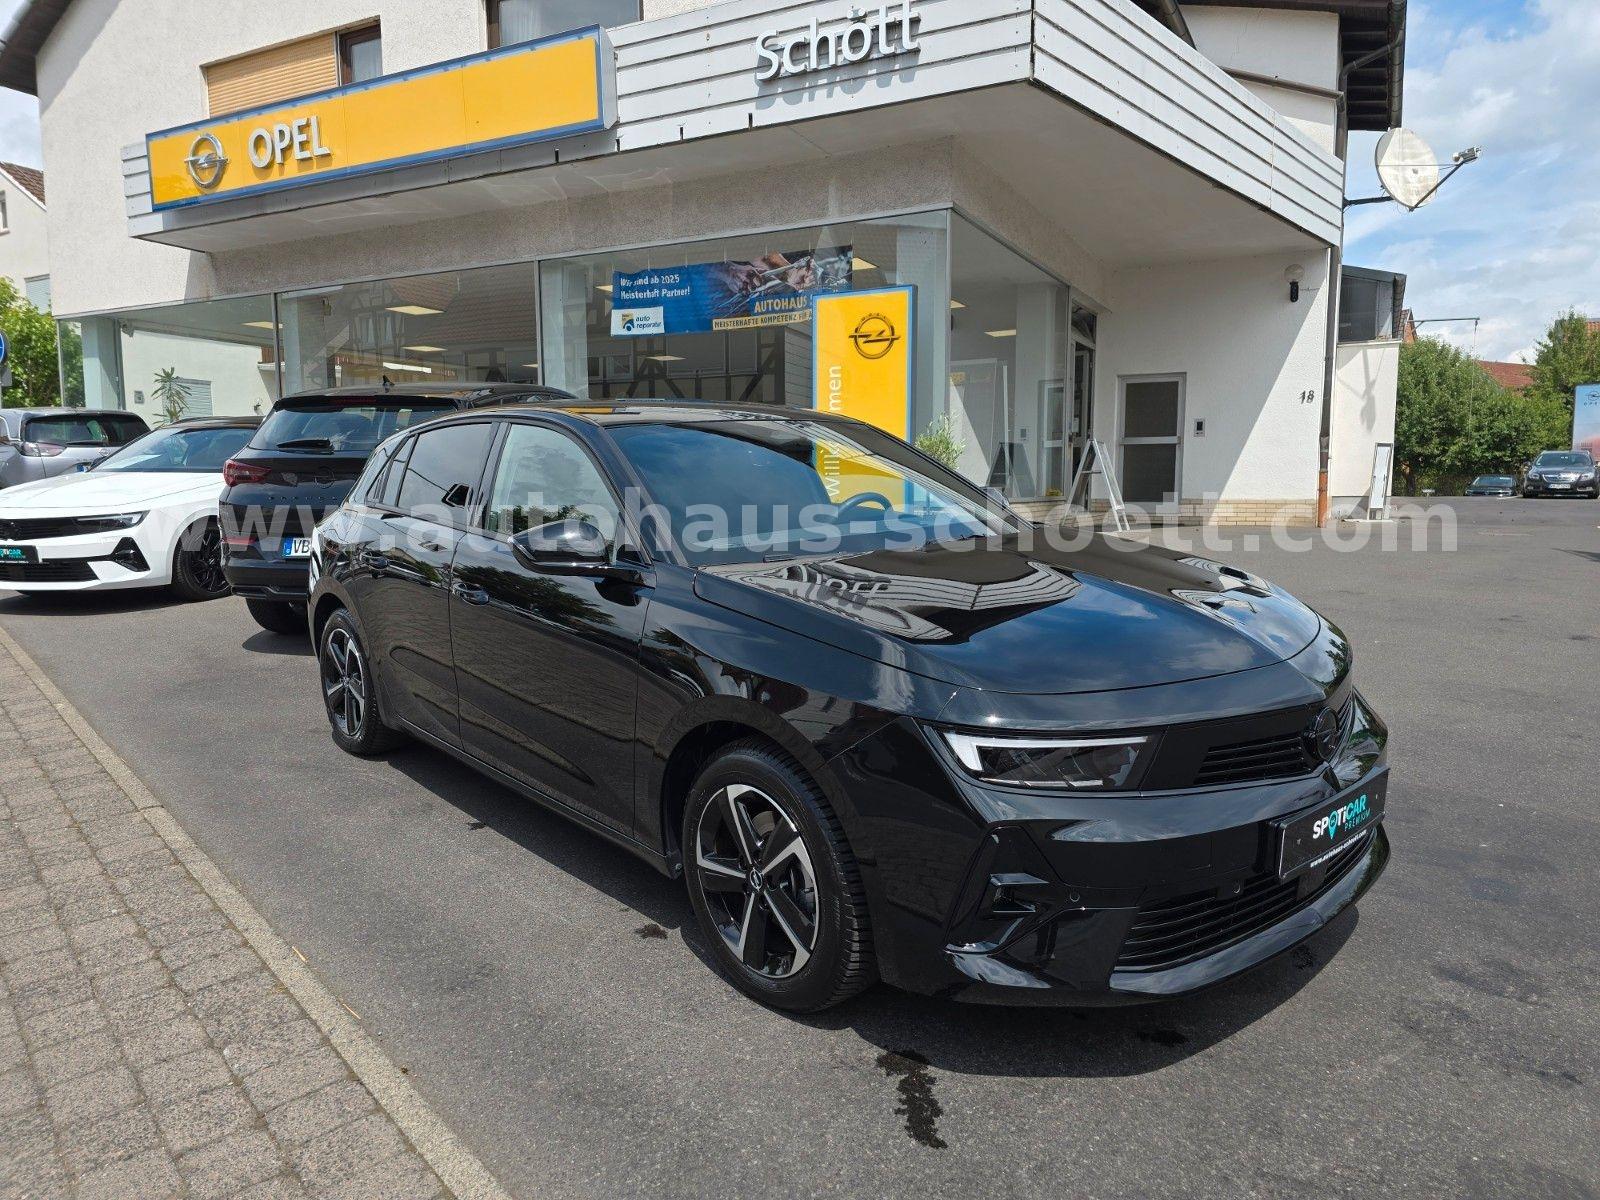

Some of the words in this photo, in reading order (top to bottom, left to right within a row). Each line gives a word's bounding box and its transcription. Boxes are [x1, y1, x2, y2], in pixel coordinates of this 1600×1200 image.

[755, 0, 921, 81] Schött
[248, 115, 331, 168] OPEL
[620, 277, 633, 287] Wir
[634, 275, 649, 286] sind
[650, 275, 660, 284] ab
[661, 274, 680, 284] 2025
[620, 288, 660, 300] Meisterhaft
[661, 285, 691, 298] Partner!
[754, 295, 808, 313] AUTOHAUS
[714, 318, 759, 329] MEISTERHAFTE
[760, 313, 798, 325] KOMPETENZ
[1299, 390, 1315, 404] 18
